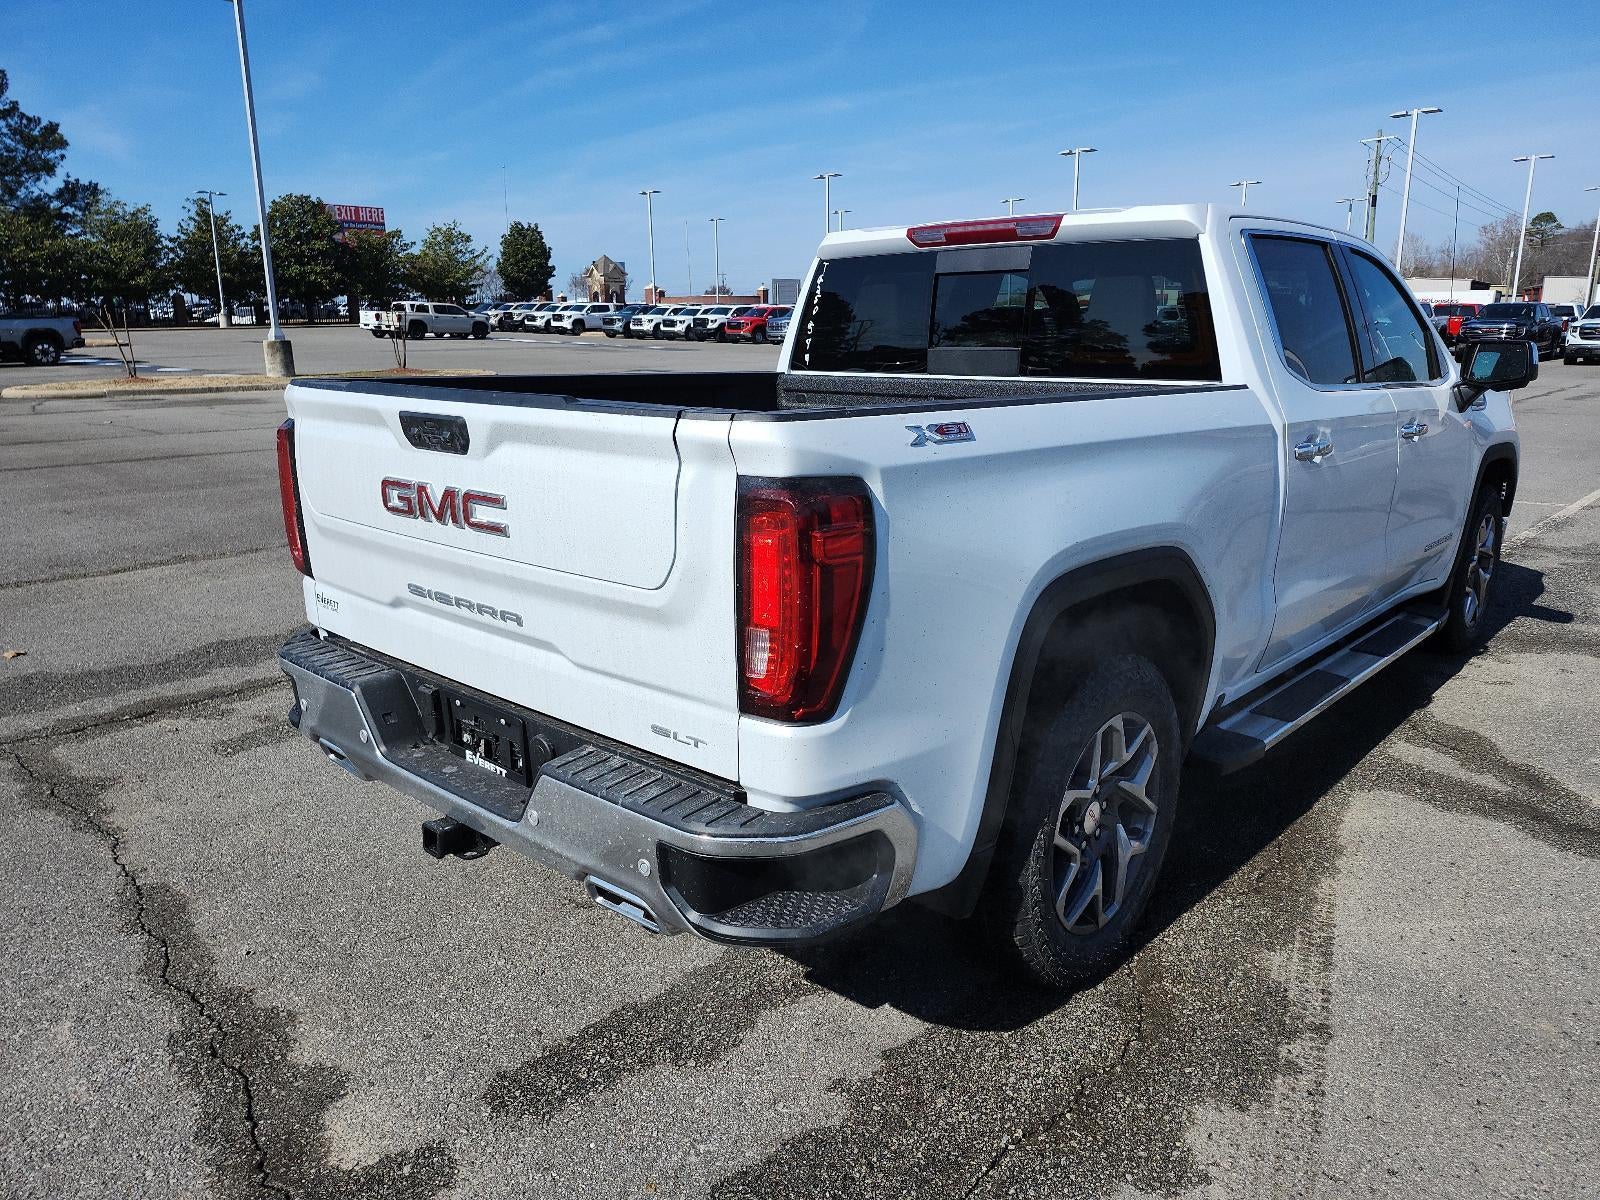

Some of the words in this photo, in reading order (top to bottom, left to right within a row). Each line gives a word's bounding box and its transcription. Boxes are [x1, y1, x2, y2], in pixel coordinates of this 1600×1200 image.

[335, 205, 356, 220] EXIT
[359, 207, 385, 222] HERE
[381, 476, 510, 538] GMC
[408, 582, 524, 628] SIERRA
[650, 723, 708, 749] SLT
[465, 749, 507, 778] EVERETT
